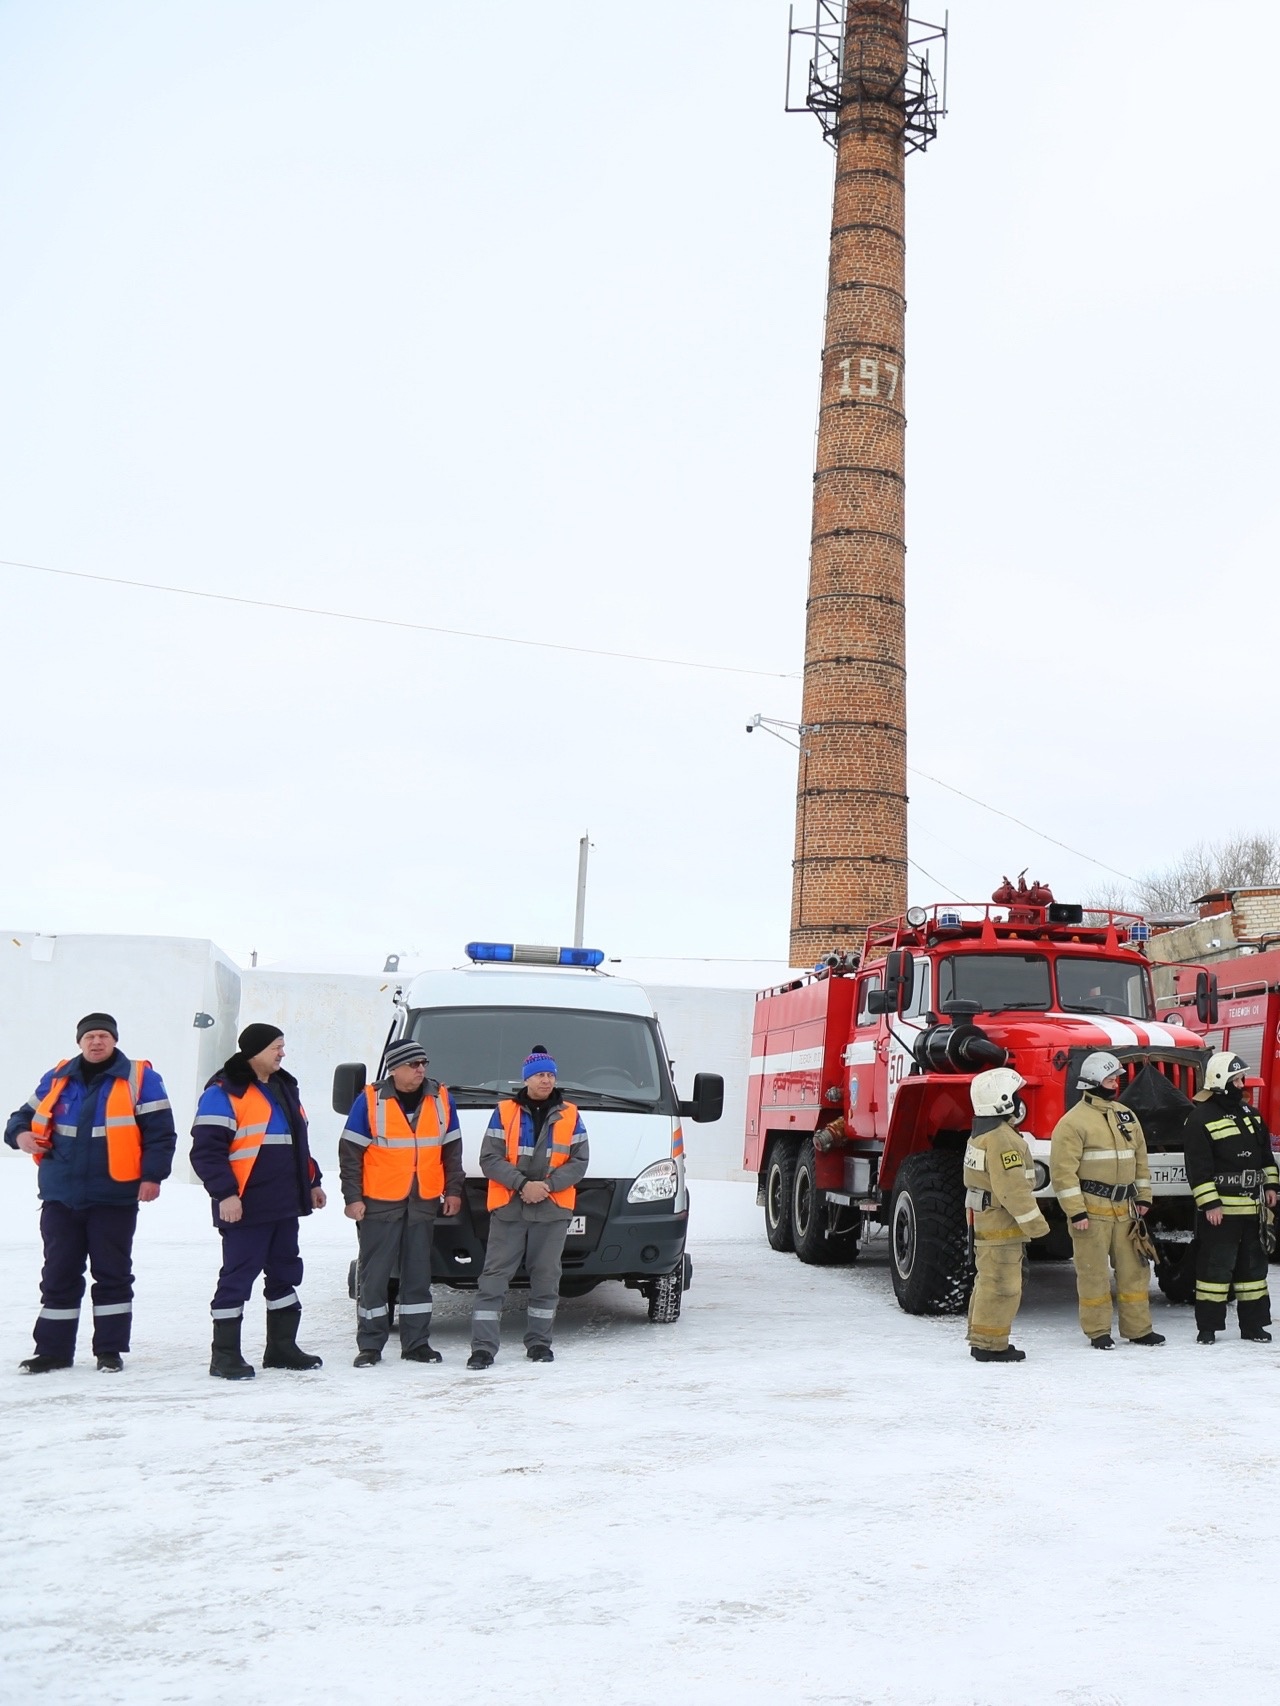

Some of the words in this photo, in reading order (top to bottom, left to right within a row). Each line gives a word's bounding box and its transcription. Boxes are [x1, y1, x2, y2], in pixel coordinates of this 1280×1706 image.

[838, 358, 899, 400] 197
[1229, 1007, 1251, 1018] ТЕЛЕФОН
[889, 1054, 904, 1085] 50
[1103, 1061, 1115, 1072] 50
[1232, 1062, 1241, 1071] 50
[1173, 1168, 1184, 1179] 71
